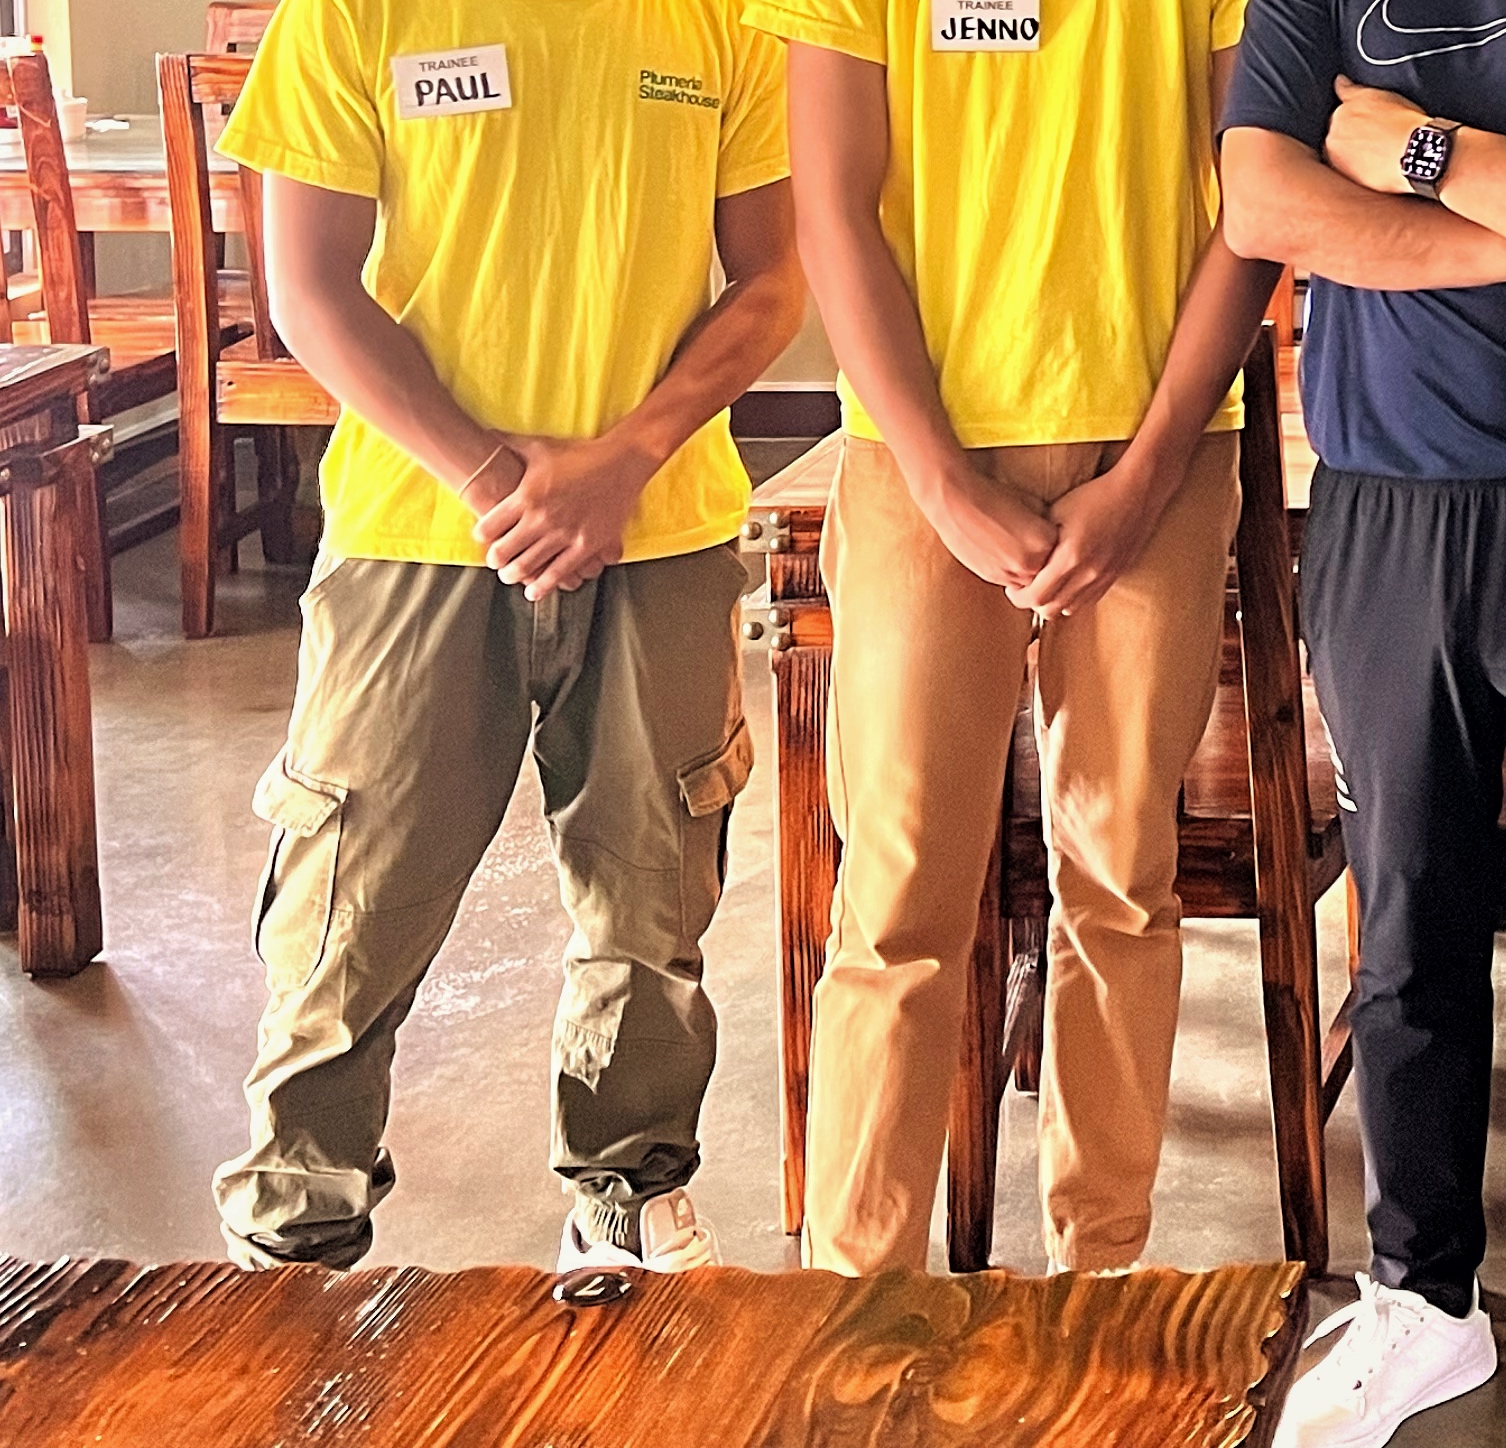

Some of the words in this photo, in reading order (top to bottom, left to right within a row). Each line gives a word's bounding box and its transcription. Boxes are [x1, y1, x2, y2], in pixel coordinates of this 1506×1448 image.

[957, 0, 1014, 11] TRAINEE
[940, 16, 1040, 41] JENNO
[418, 55, 479, 72] TRAINEE
[414, 72, 501, 107] PAUL
[640, 70, 702, 91] Plumeria
[639, 84, 720, 109] Steakhouse
